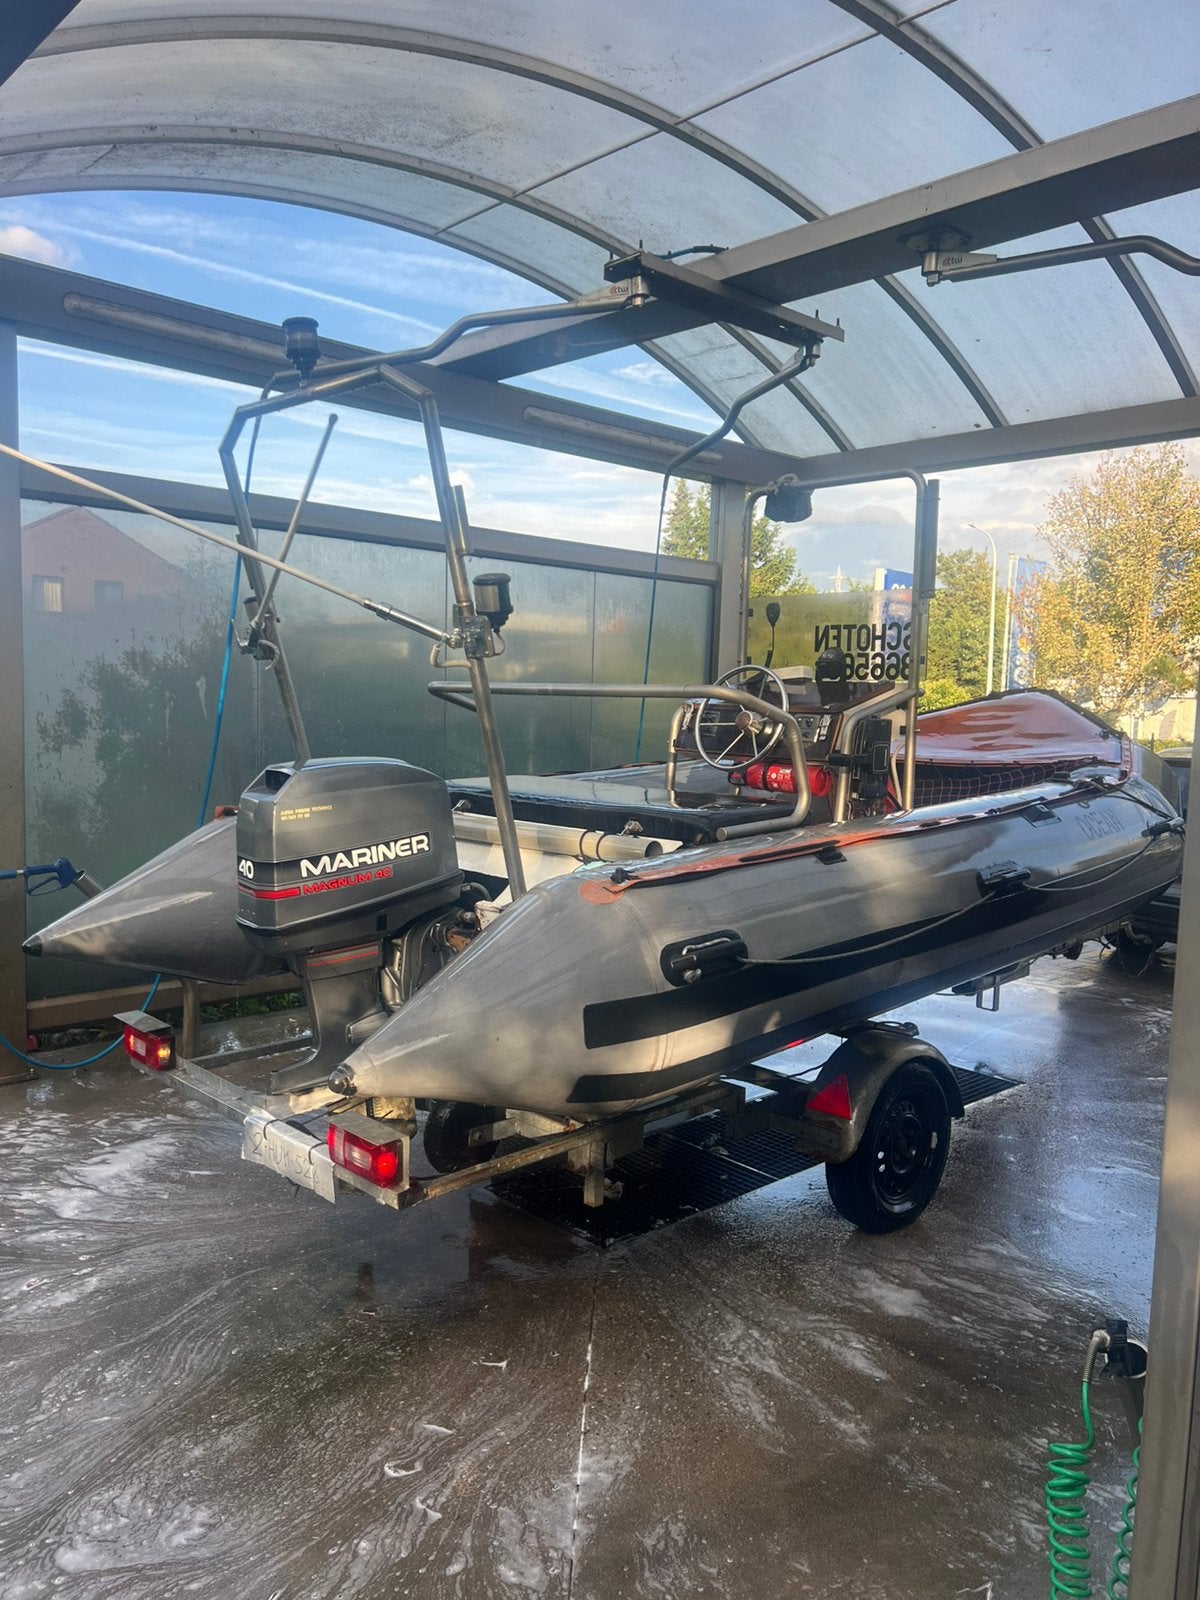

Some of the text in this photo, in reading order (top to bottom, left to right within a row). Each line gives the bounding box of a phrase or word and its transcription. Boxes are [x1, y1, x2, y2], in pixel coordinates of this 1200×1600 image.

[1075, 806, 1126, 841] OCEAN
[239, 859, 254, 879] 40
[300, 834, 430, 878] MARINER
[303, 867, 392, 895] MAGNUM 40
